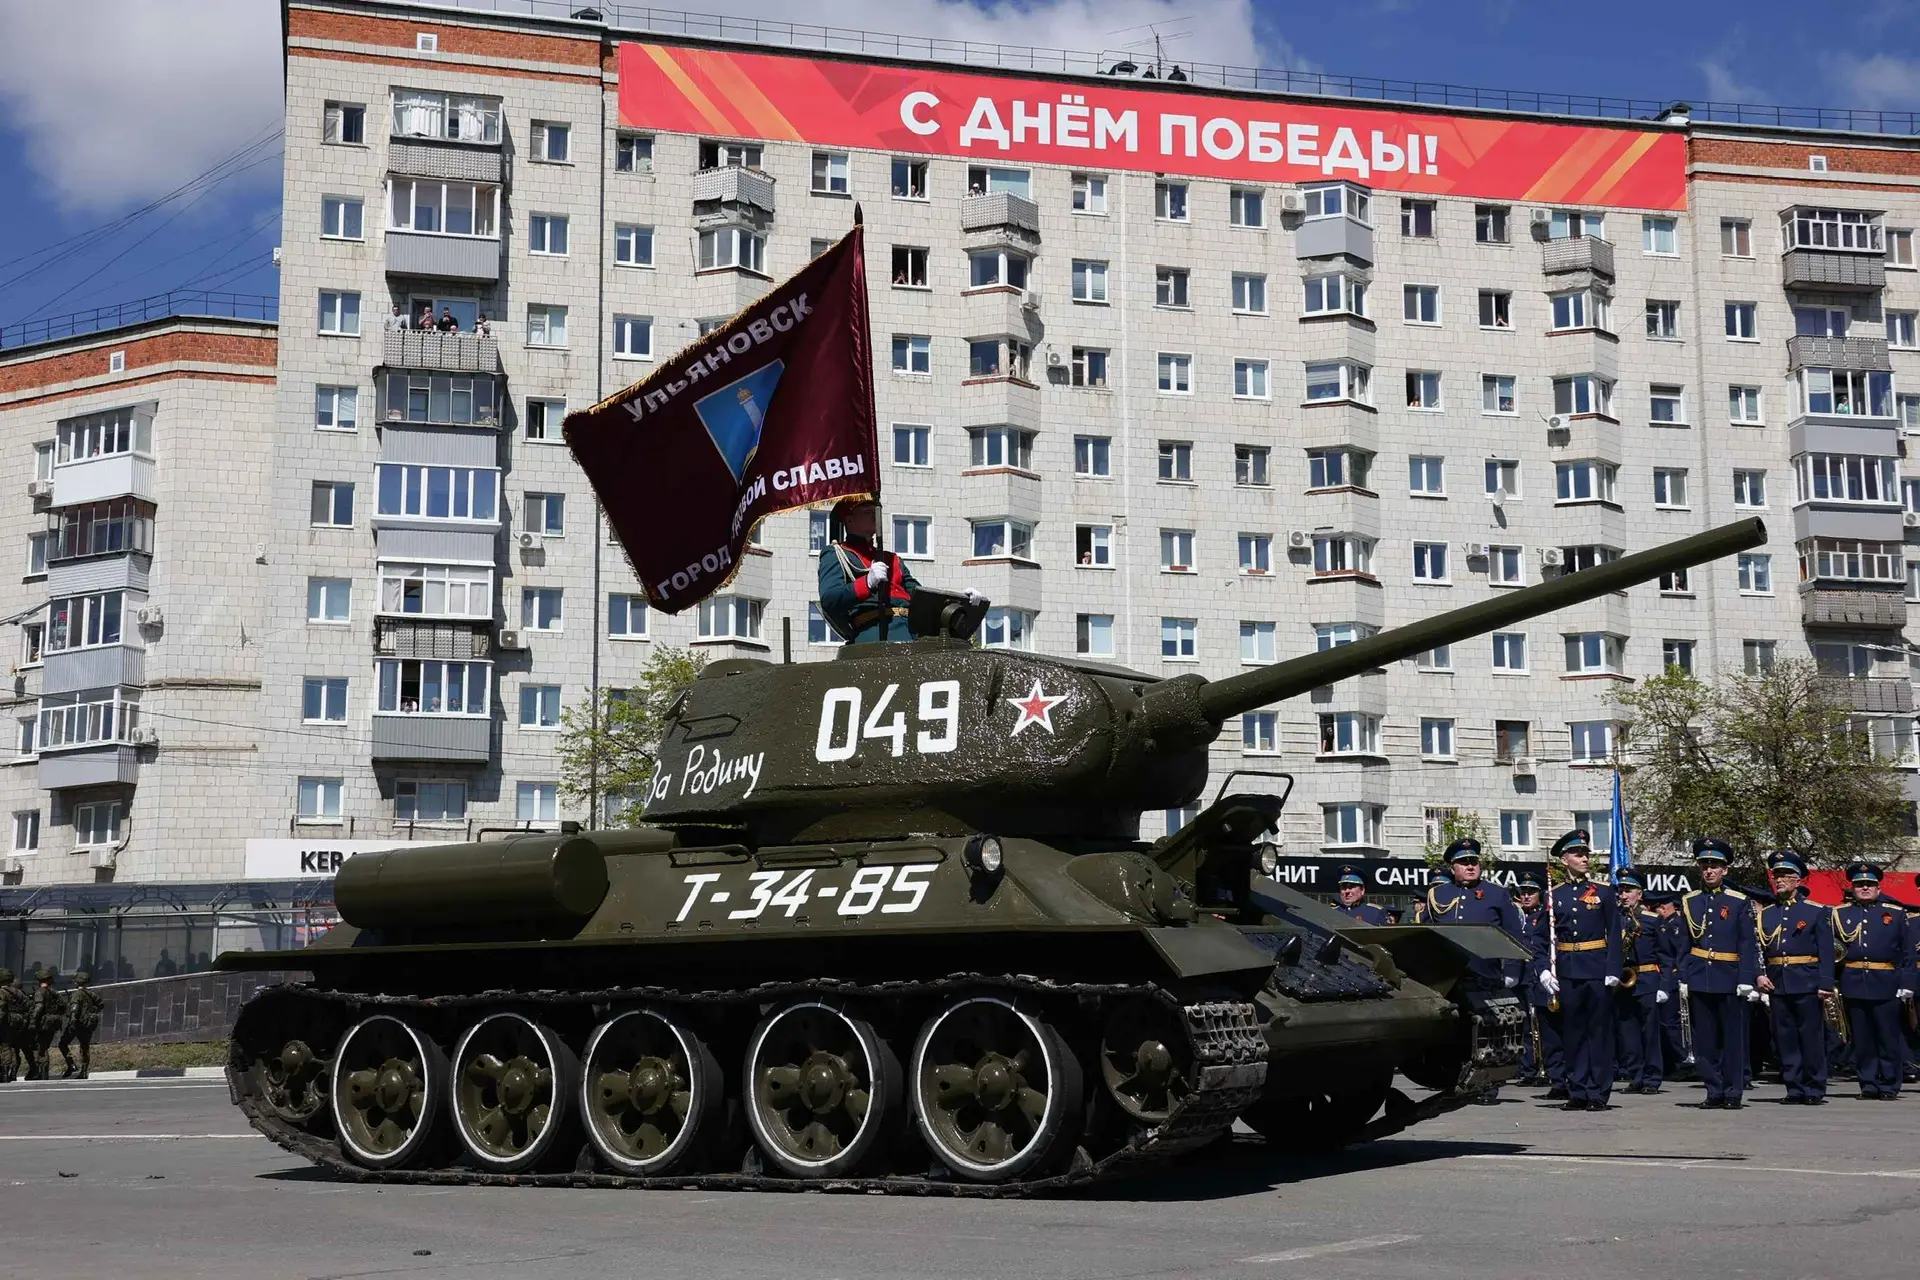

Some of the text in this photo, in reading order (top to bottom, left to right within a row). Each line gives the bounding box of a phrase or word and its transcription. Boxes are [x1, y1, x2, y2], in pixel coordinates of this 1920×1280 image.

[900, 91, 1437, 178] С ДНЁМ ПОБЕДЫ!
[622, 292, 813, 422] УЛЬЯНОВСК
[657, 454, 864, 599] ГОРОД ДОВОЙ СЛАВЫ
[815, 679, 960, 763] 049
[644, 744, 765, 808] За Родину
[301, 851, 357, 873] KER
[675, 863, 940, 922] Т-34-85
[1265, 865, 1320, 883] НИТ
